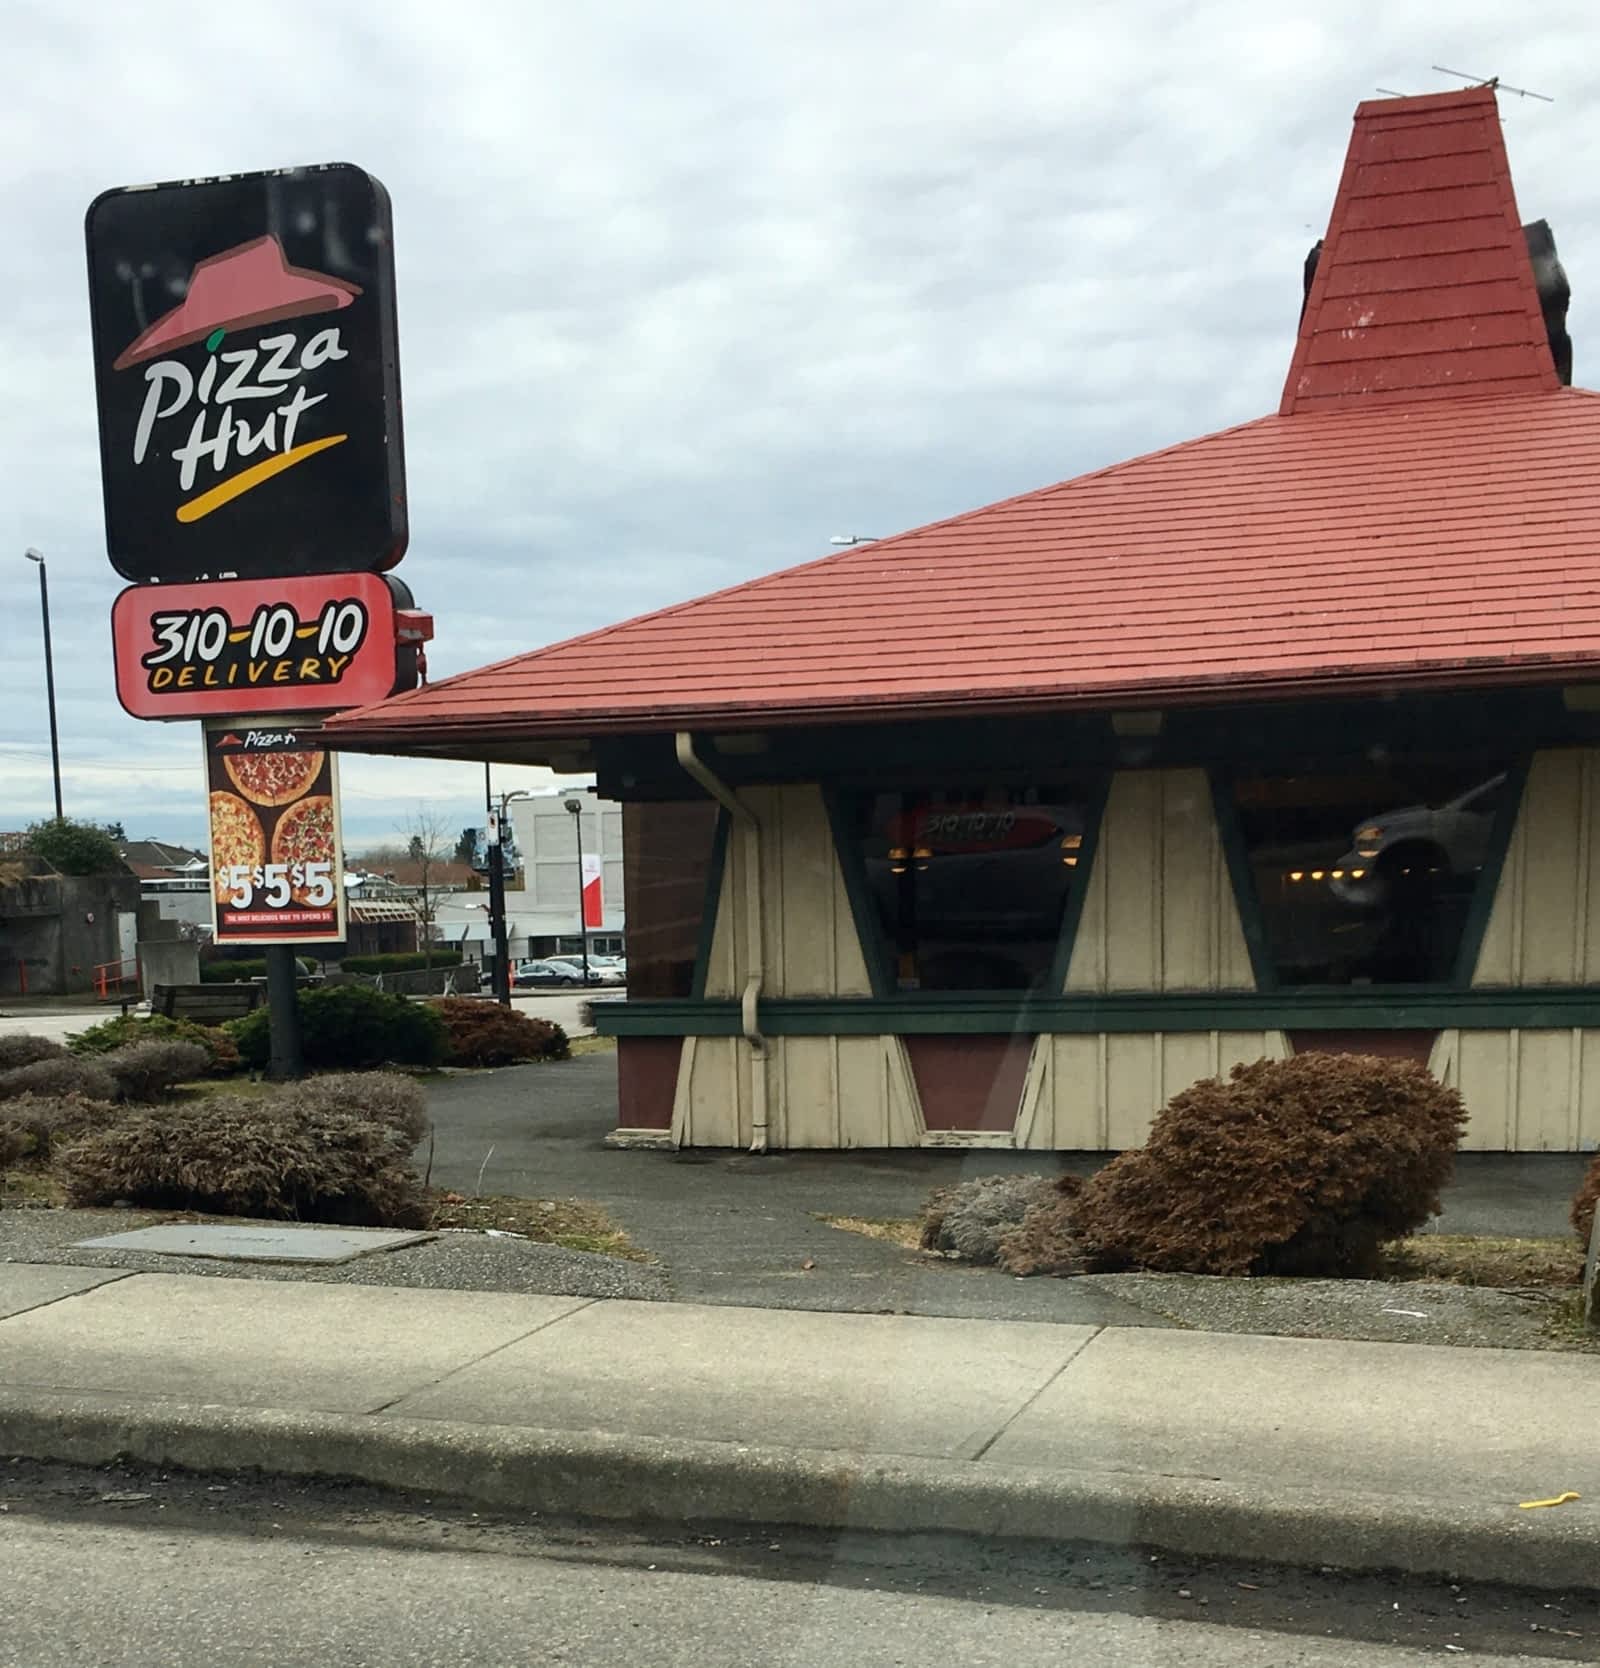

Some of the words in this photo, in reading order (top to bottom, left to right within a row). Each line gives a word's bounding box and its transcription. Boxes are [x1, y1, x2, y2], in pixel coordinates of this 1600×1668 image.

[134, 327, 348, 465] Pizza
[172, 385, 328, 491] Hut
[147, 604, 363, 664] 310-10-10
[152, 655, 349, 689] DELIVERY
[244, 730, 284, 749] Pizza
[301, 912, 321, 921] SPEND
